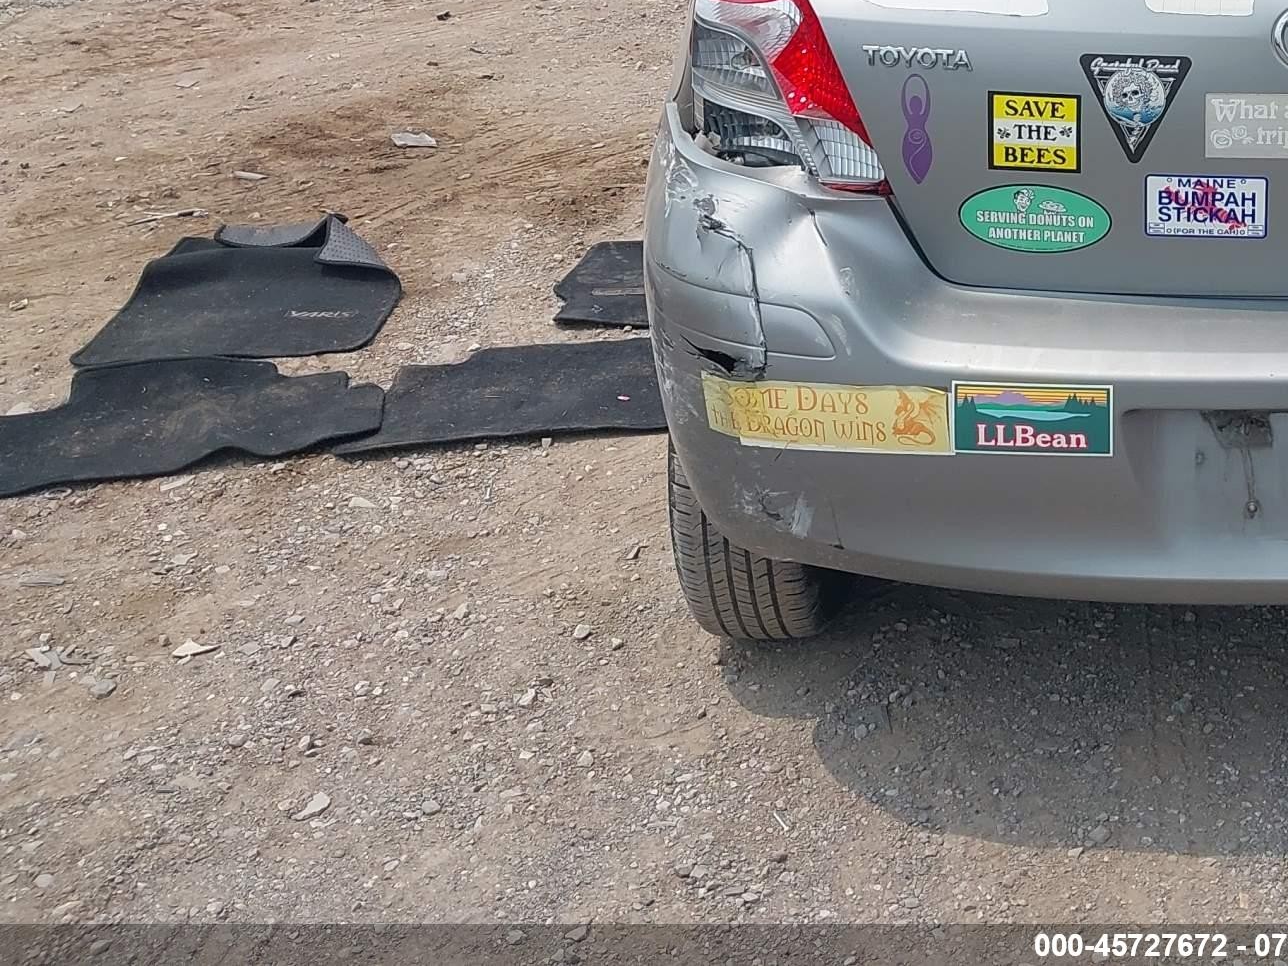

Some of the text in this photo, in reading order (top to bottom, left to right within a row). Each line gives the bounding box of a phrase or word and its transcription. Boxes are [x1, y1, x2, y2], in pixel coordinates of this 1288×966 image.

[862, 44, 973, 72] TOYOTA
[1146, 59, 1181, 72] Dead
[1005, 99, 1066, 119] SAVE
[1211, 98, 1278, 122] What
[1013, 124, 1057, 141] THE
[1004, 146, 1067, 165] BEES
[1177, 178, 1236, 189] MAINE
[1158, 190, 1256, 207] BUMPAH
[976, 210, 1094, 228] SERVING DONUTS ON
[1158, 206, 1256, 224] STICKAH
[988, 227, 1085, 243] ANOTHER PLANET
[1197, 227, 1215, 235] THE
